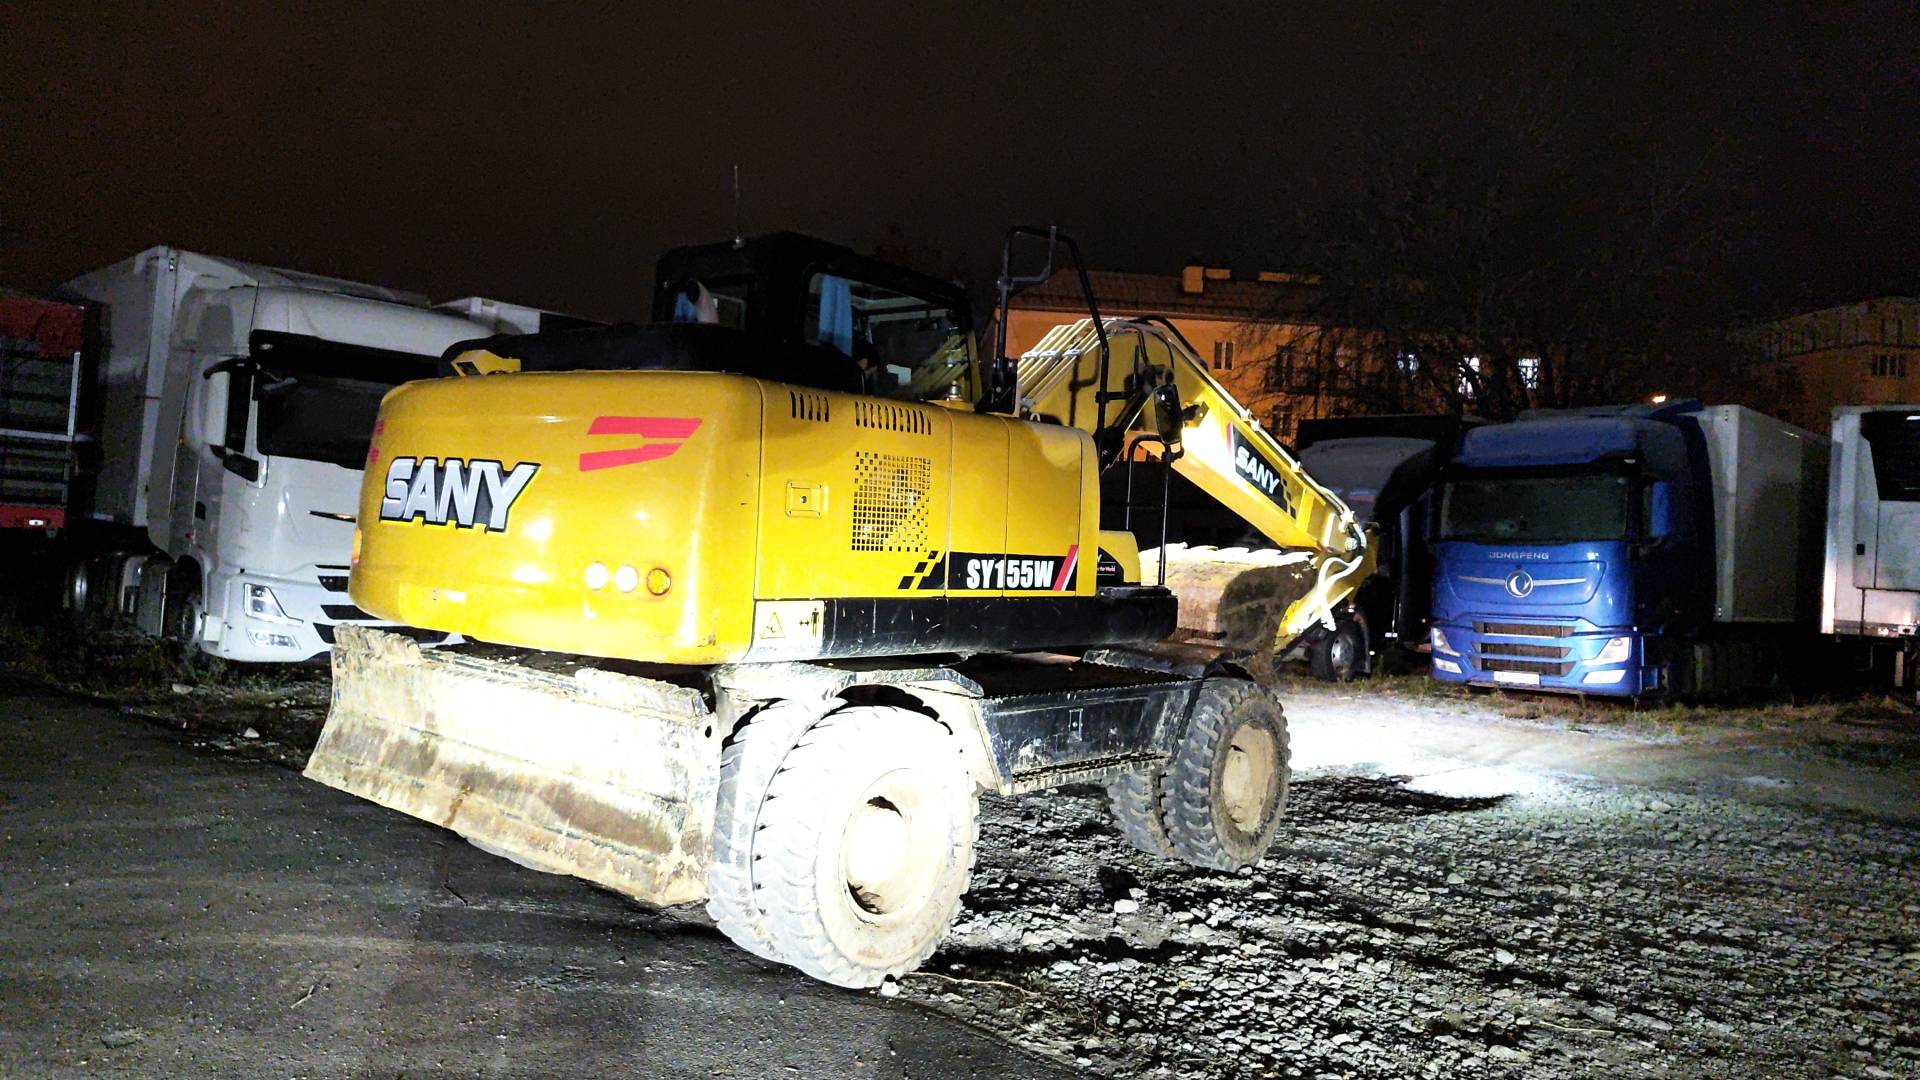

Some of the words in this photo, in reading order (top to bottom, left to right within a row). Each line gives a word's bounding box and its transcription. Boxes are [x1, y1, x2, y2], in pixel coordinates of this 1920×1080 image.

[1235, 446, 1280, 494] SANY
[380, 456, 541, 533] SANY
[966, 559, 1055, 589] SY155W
[1488, 551, 1550, 560] DONGFENG
